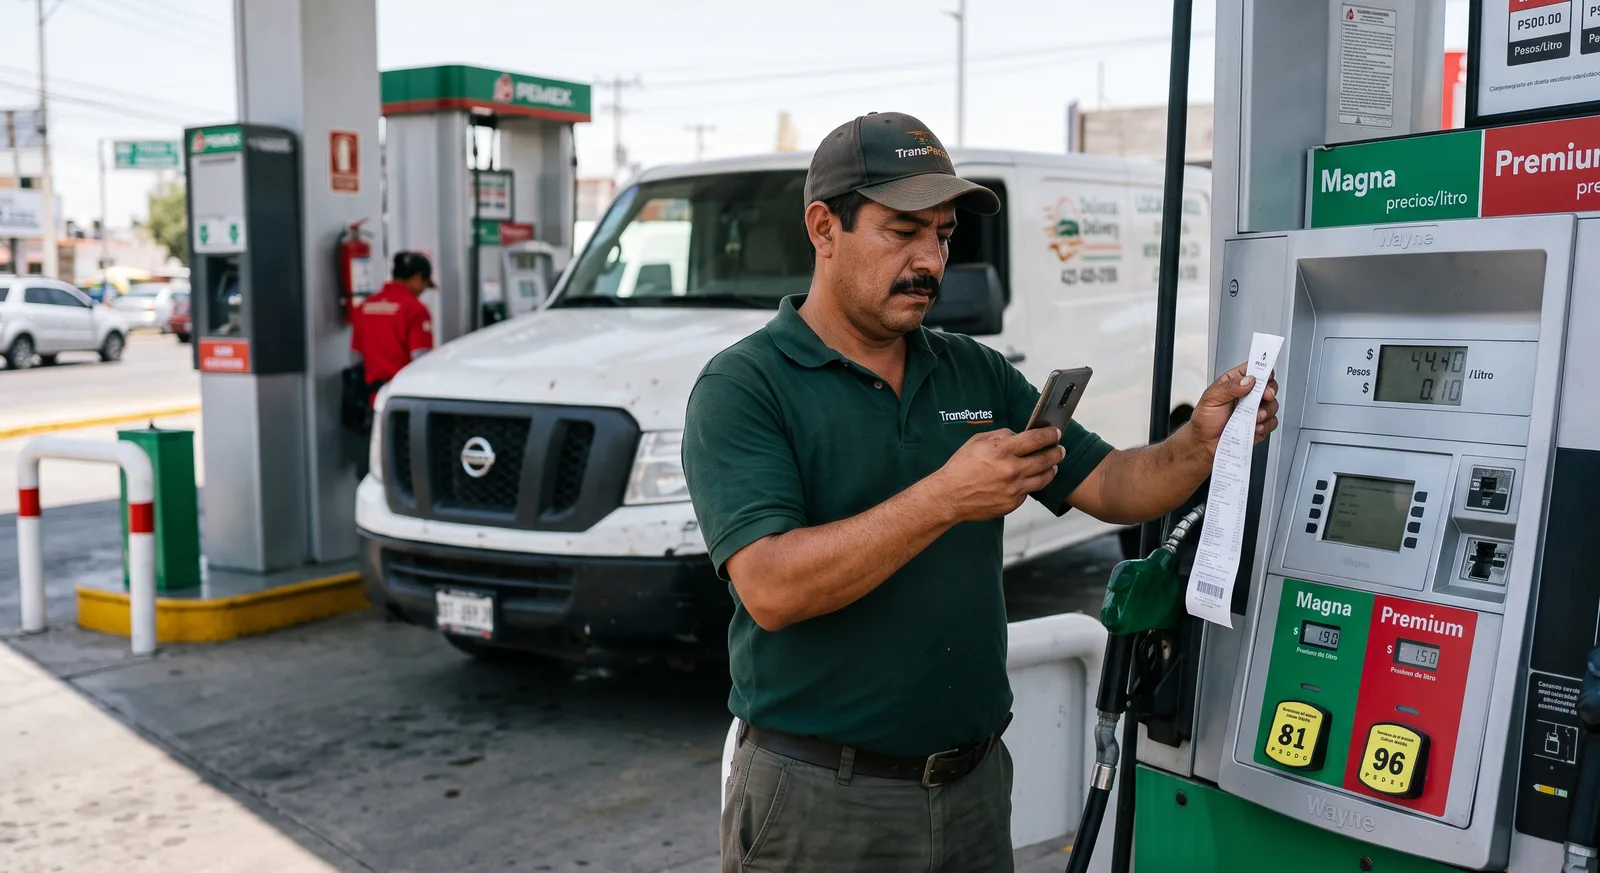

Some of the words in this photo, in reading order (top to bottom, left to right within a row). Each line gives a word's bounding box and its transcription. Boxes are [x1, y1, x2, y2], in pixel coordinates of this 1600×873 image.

[1517, 12, 1562, 30] PS00.00
[1514, 41, 1563, 56] Pesos/Litro
[1321, 168, 1396, 198] Magna
[1386, 190, 1468, 215] precios/litro
[1379, 228, 1435, 250] Wayne
[1366, 348, 1374, 360] $
[1346, 366, 1371, 377] Pesos
[1362, 382, 1369, 394] $
[939, 409, 993, 421] TransPortes
[1295, 591, 1353, 617] Magna
[1380, 606, 1464, 638] Premium
[1414, 671, 1423, 679] de
[1277, 723, 1306, 750] 81
[1372, 747, 1406, 776] 96
[1306, 793, 1375, 832] Wayne
